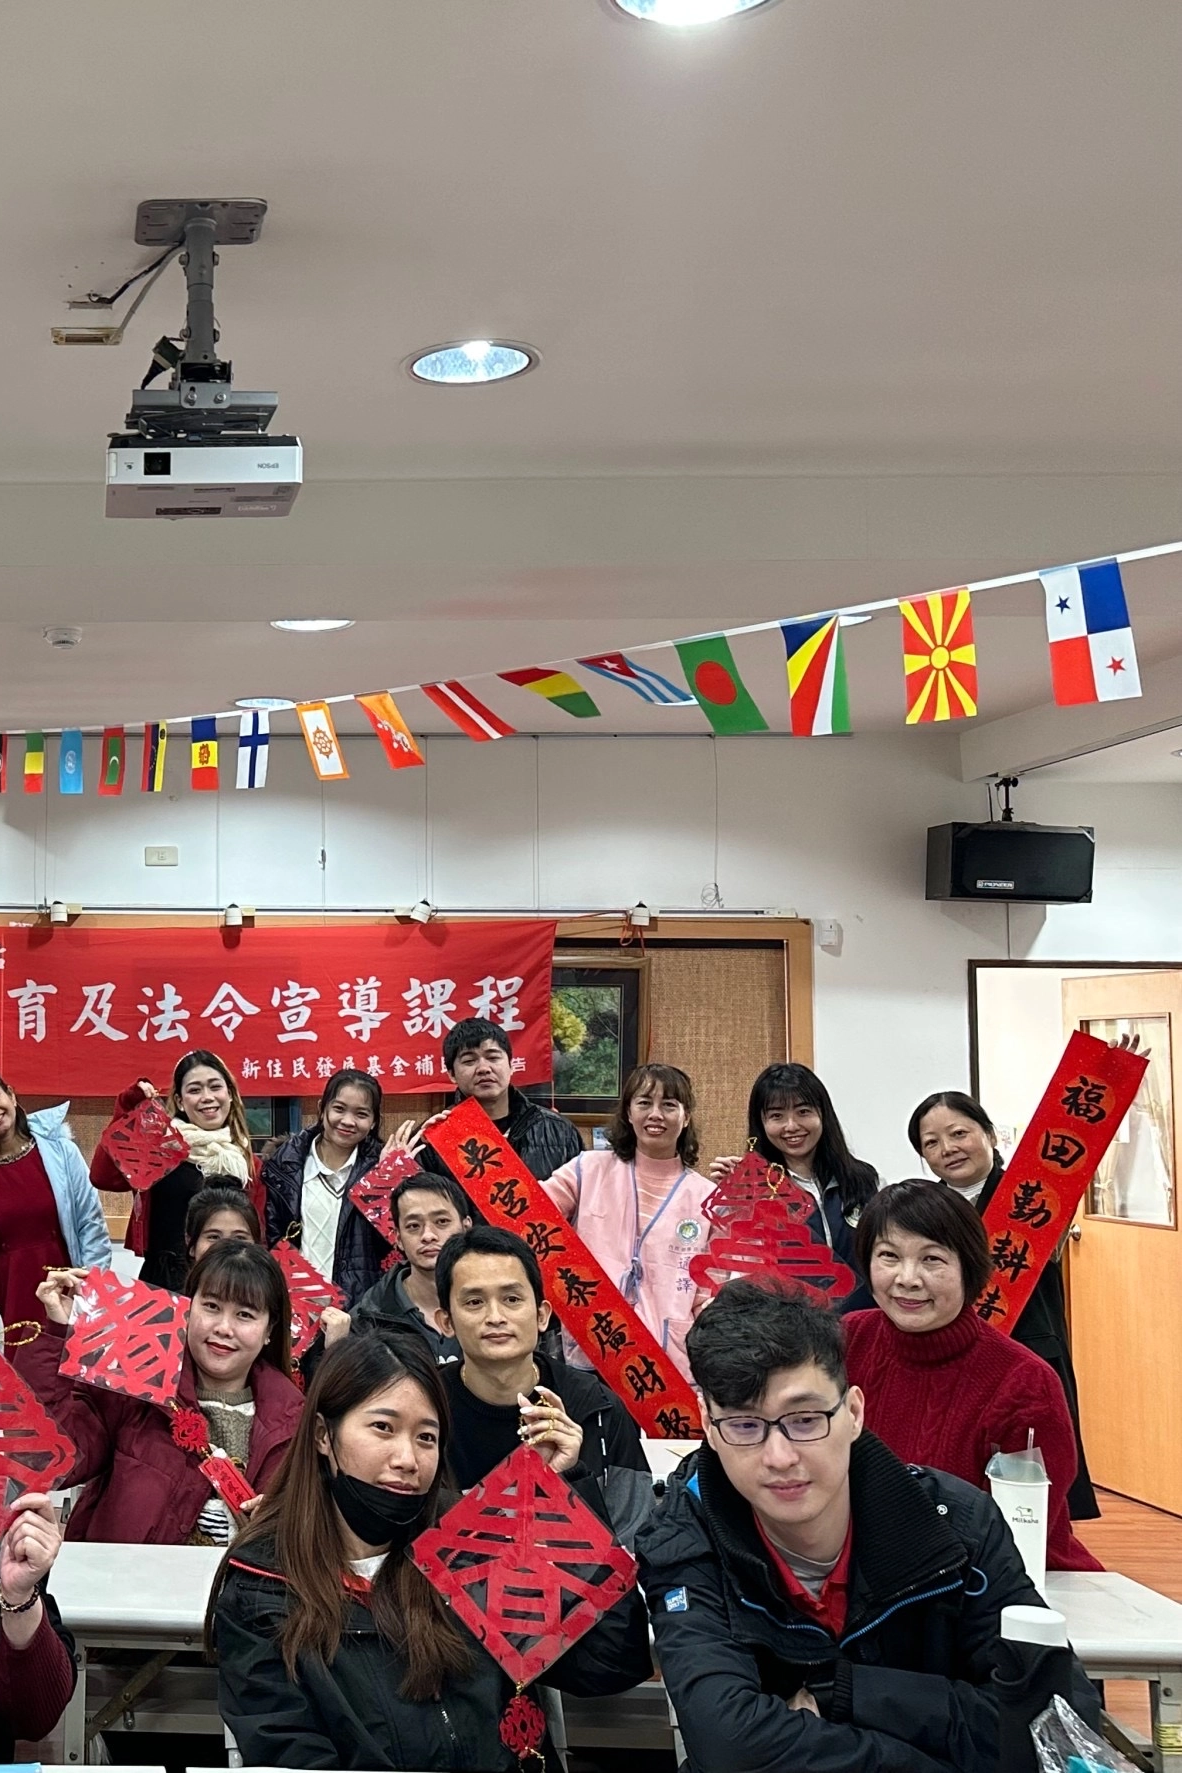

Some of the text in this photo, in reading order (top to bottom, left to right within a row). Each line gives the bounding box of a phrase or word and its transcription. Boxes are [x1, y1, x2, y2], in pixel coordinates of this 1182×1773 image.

[241, 1054, 527, 1080] 新住民發展基金補告
